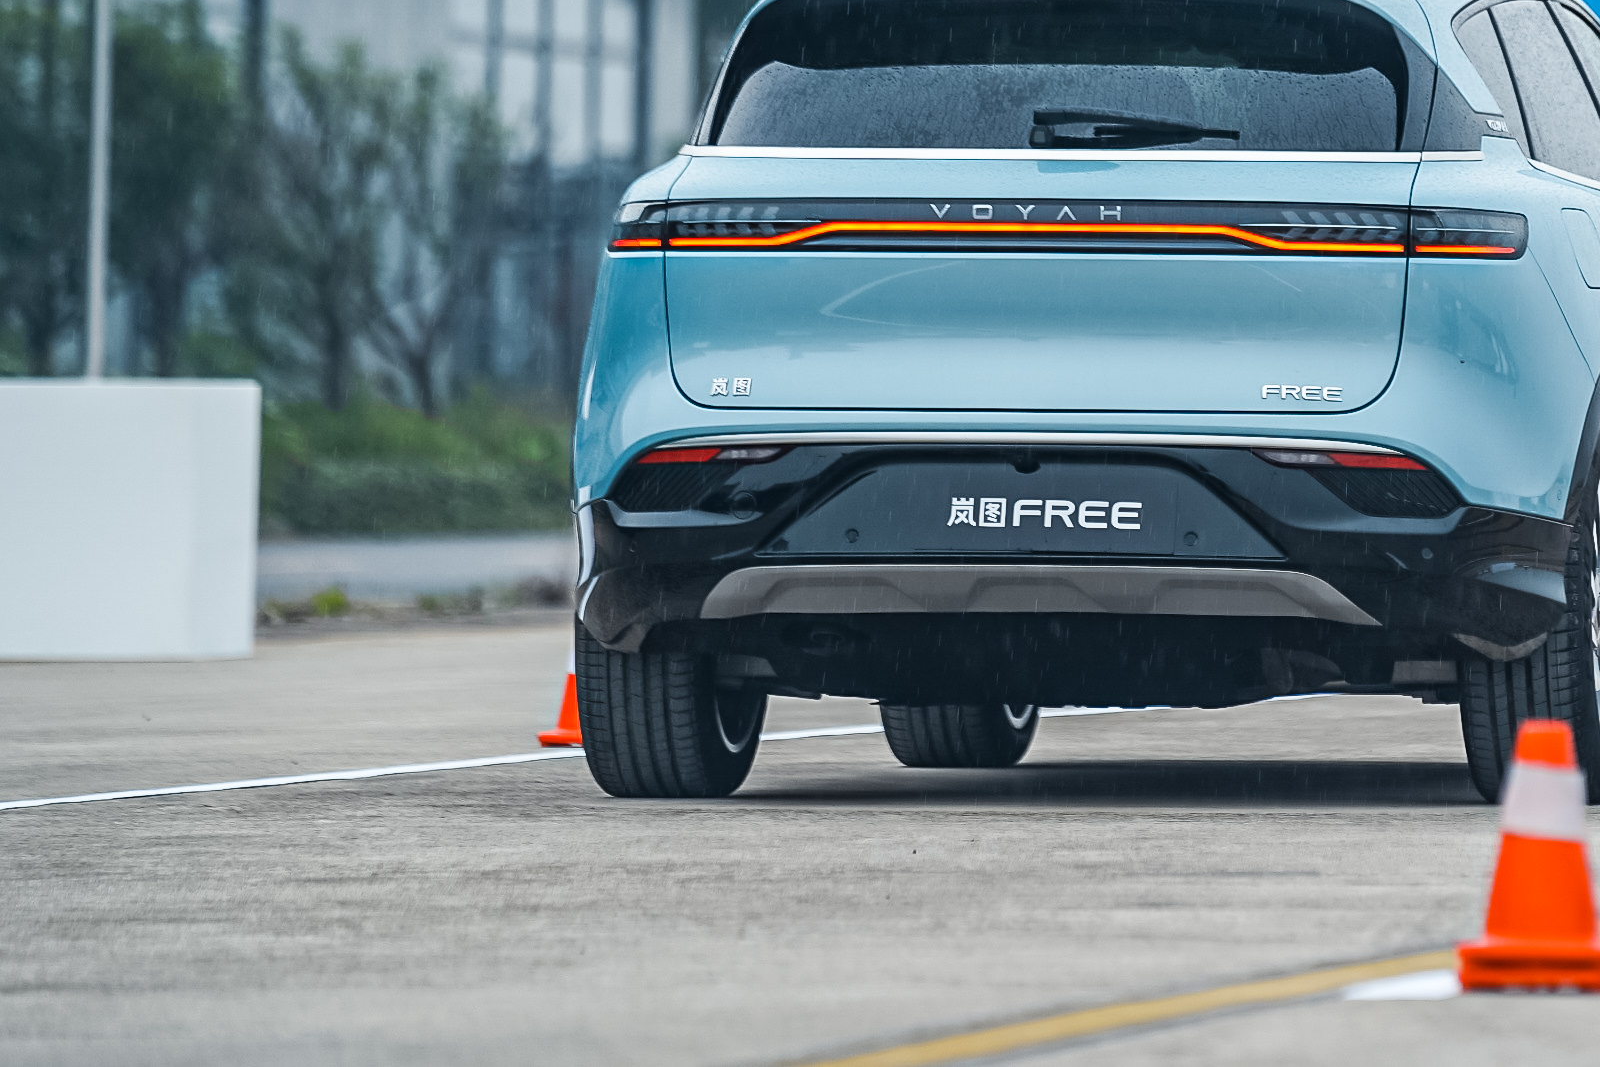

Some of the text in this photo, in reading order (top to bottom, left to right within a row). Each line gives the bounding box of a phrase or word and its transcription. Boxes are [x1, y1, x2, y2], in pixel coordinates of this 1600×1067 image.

[929, 203, 1122, 221] VOYAH
[710, 377, 752, 397] 岚图
[1261, 384, 1343, 402] FREE
